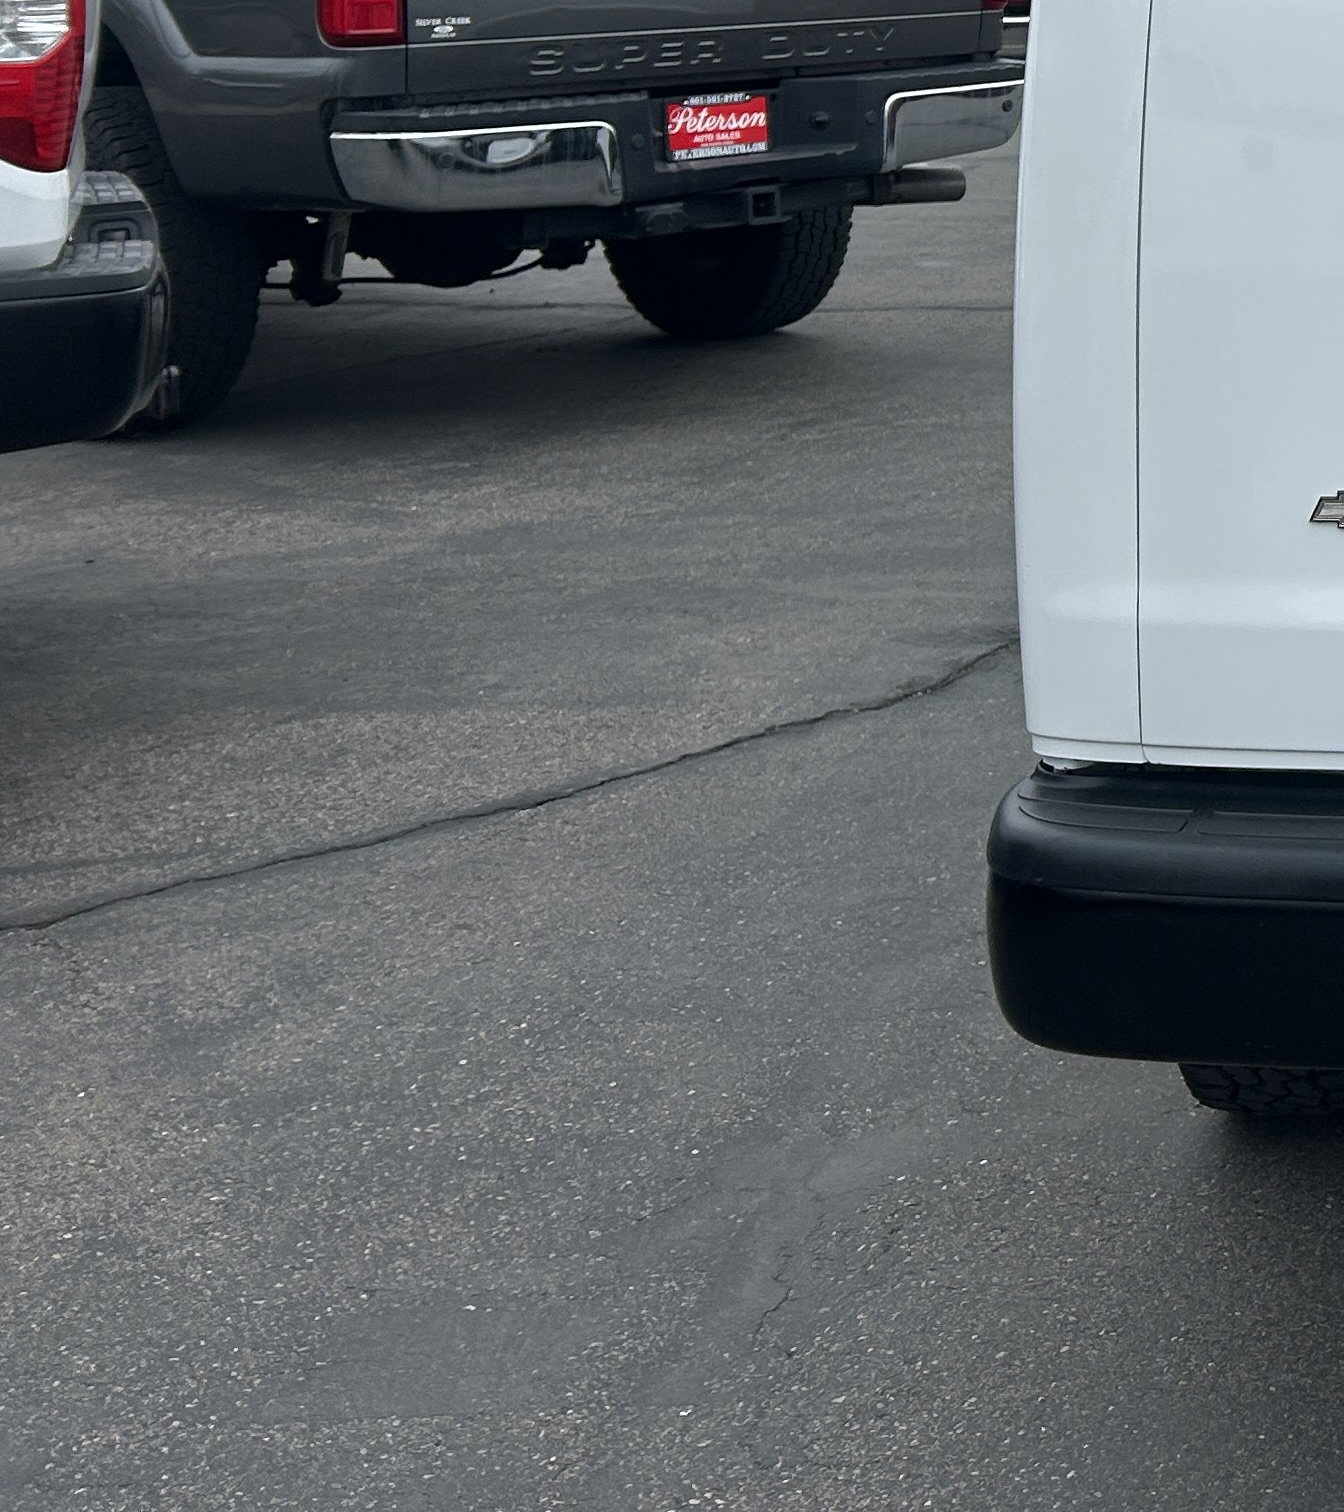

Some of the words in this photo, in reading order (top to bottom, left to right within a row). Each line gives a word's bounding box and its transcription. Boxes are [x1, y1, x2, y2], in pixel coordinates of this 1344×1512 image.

[528, 40, 723, 76] SUPER
[762, 27, 894, 60] DUTY
[668, 105, 767, 135] Peterson
